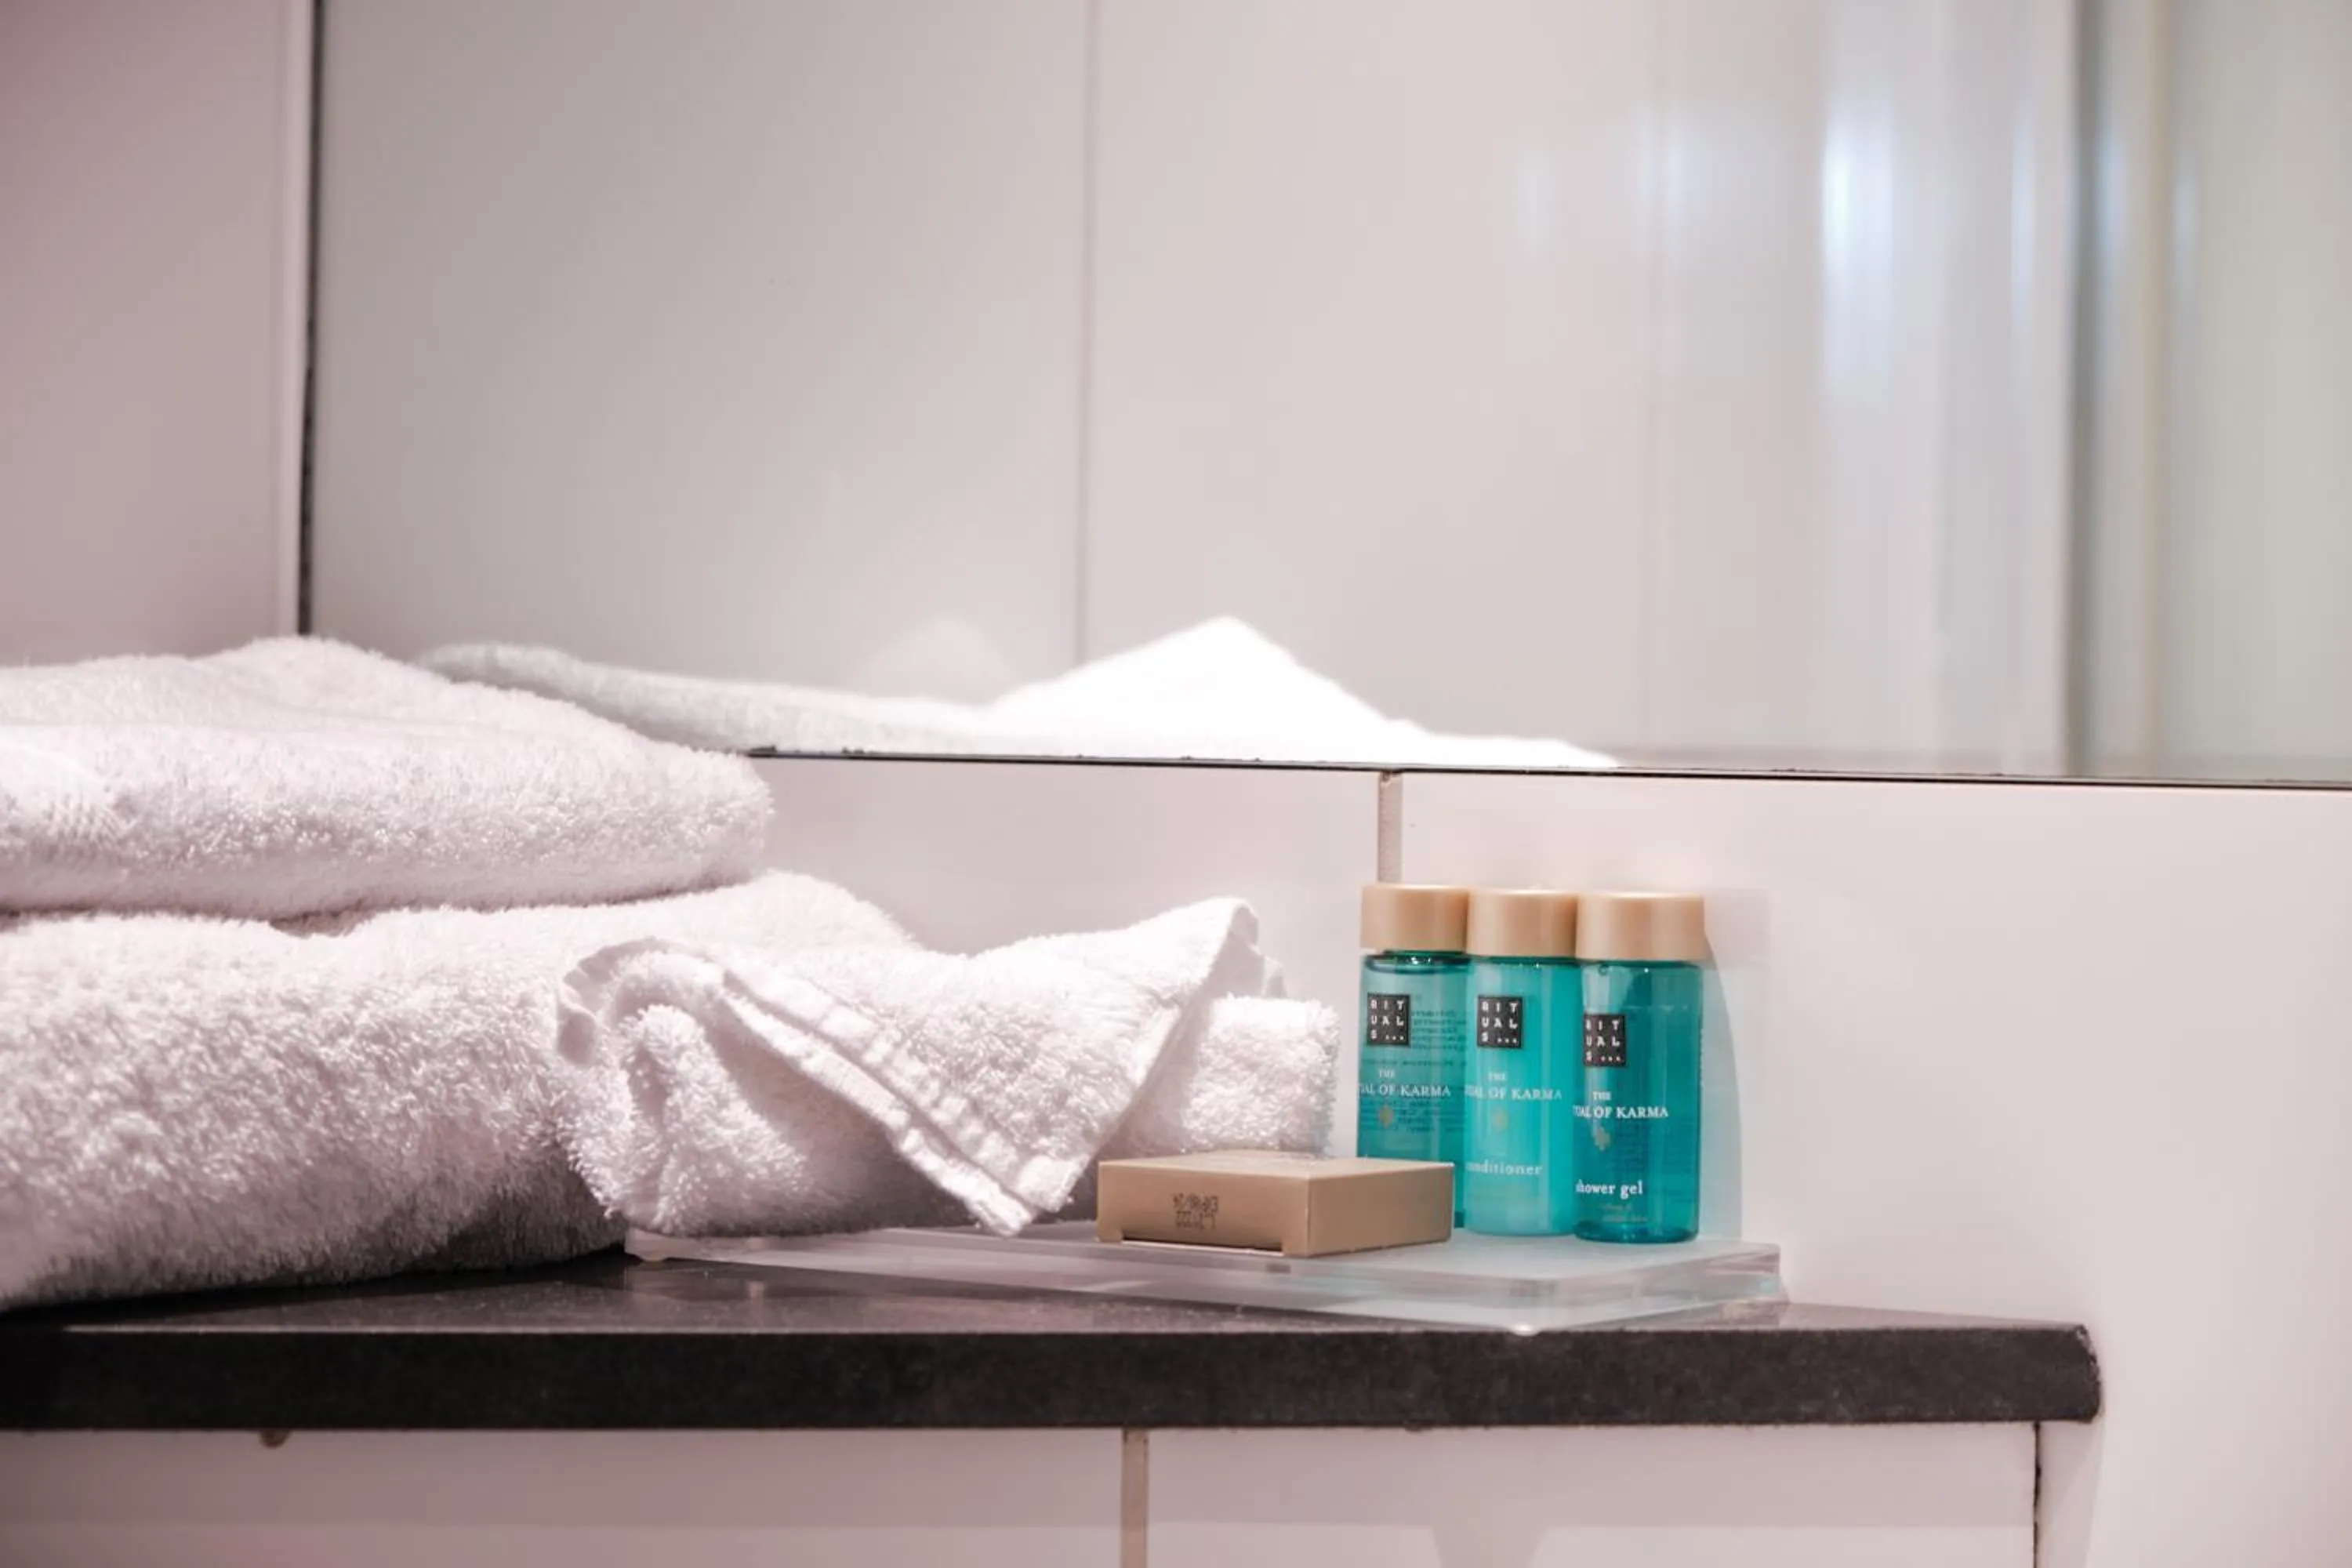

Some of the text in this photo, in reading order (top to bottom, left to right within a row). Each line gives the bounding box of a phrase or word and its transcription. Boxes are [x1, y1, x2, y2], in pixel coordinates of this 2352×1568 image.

[1379, 1084, 1396, 1097] OF
[1400, 1084, 1452, 1098] KARMA
[1489, 1087, 1507, 1100] OF
[1511, 1088, 1563, 1101] KARMA
[1592, 1091, 1612, 1102] THE
[1593, 1105, 1613, 1119] OF
[1616, 1106, 1669, 1120] KARMA
[1620, 1179, 1644, 1200] gel
